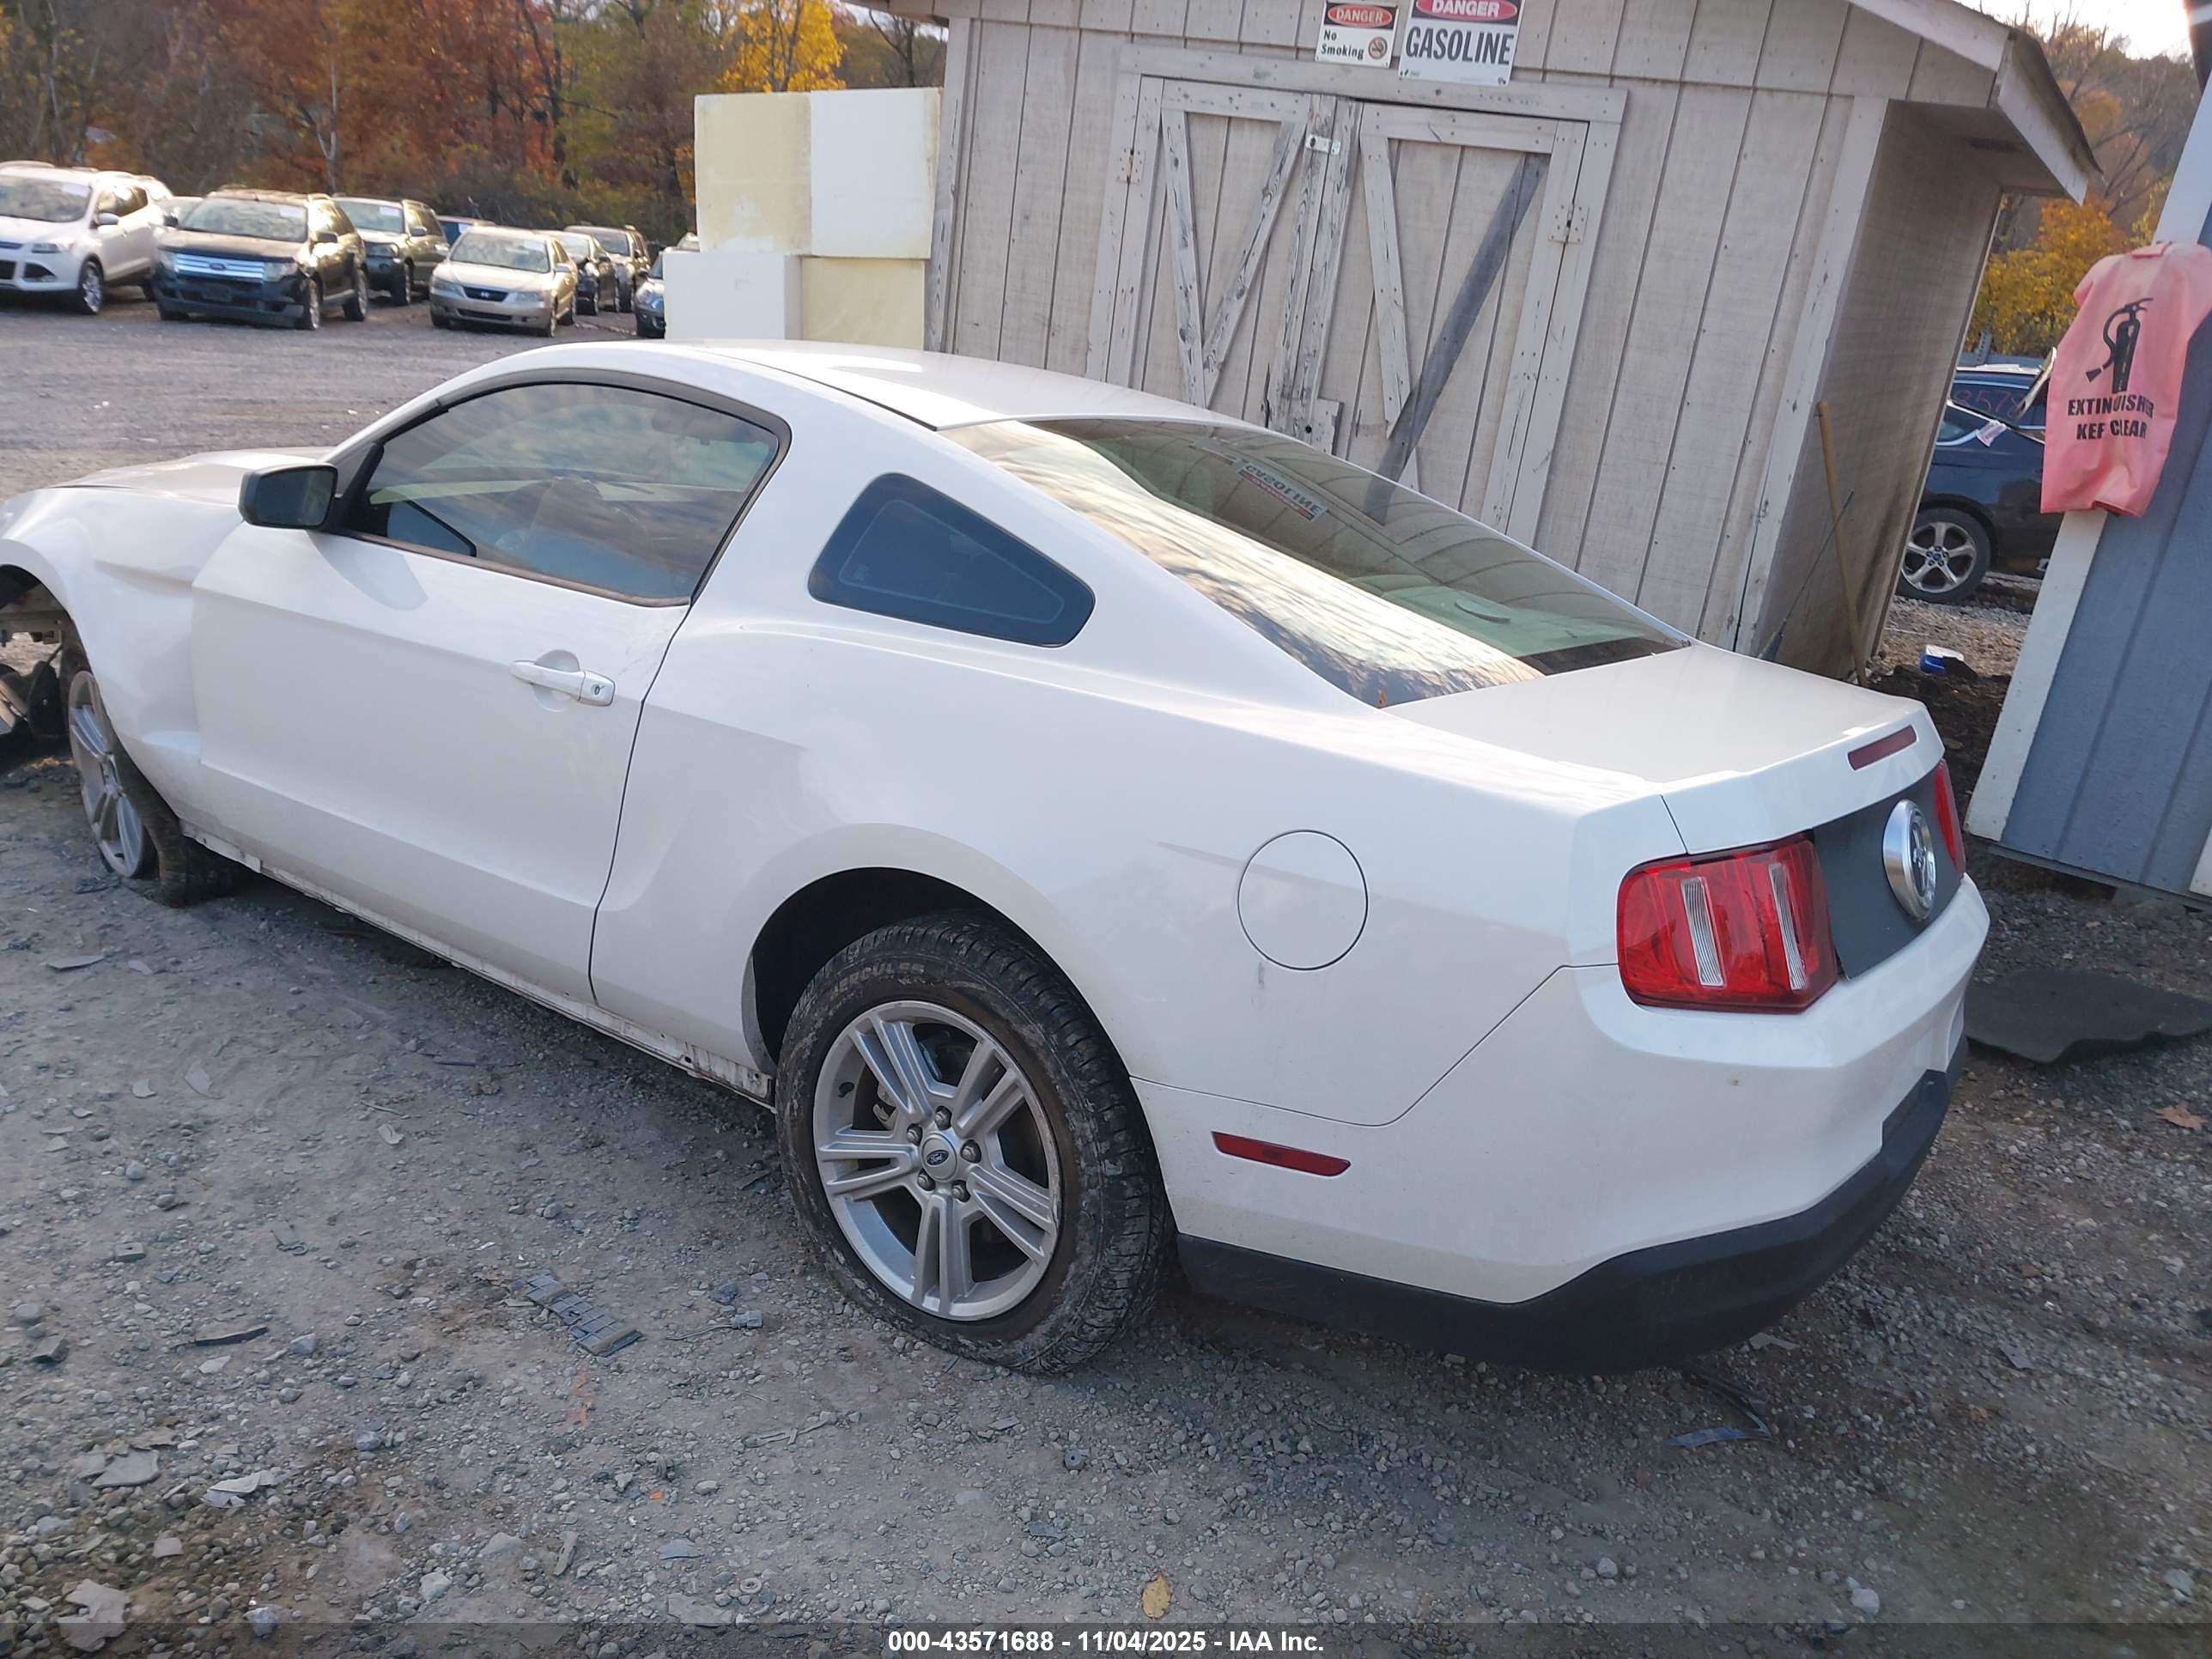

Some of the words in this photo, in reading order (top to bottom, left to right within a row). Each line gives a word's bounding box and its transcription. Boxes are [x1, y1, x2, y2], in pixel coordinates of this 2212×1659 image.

[1336, 8, 1383, 23] DANGER
[1431, 0, 1499, 16] DANGER
[1323, 29, 1337, 41] No
[1321, 44, 1364, 60] Smoking
[1406, 26, 1514, 65] GASOLINE
